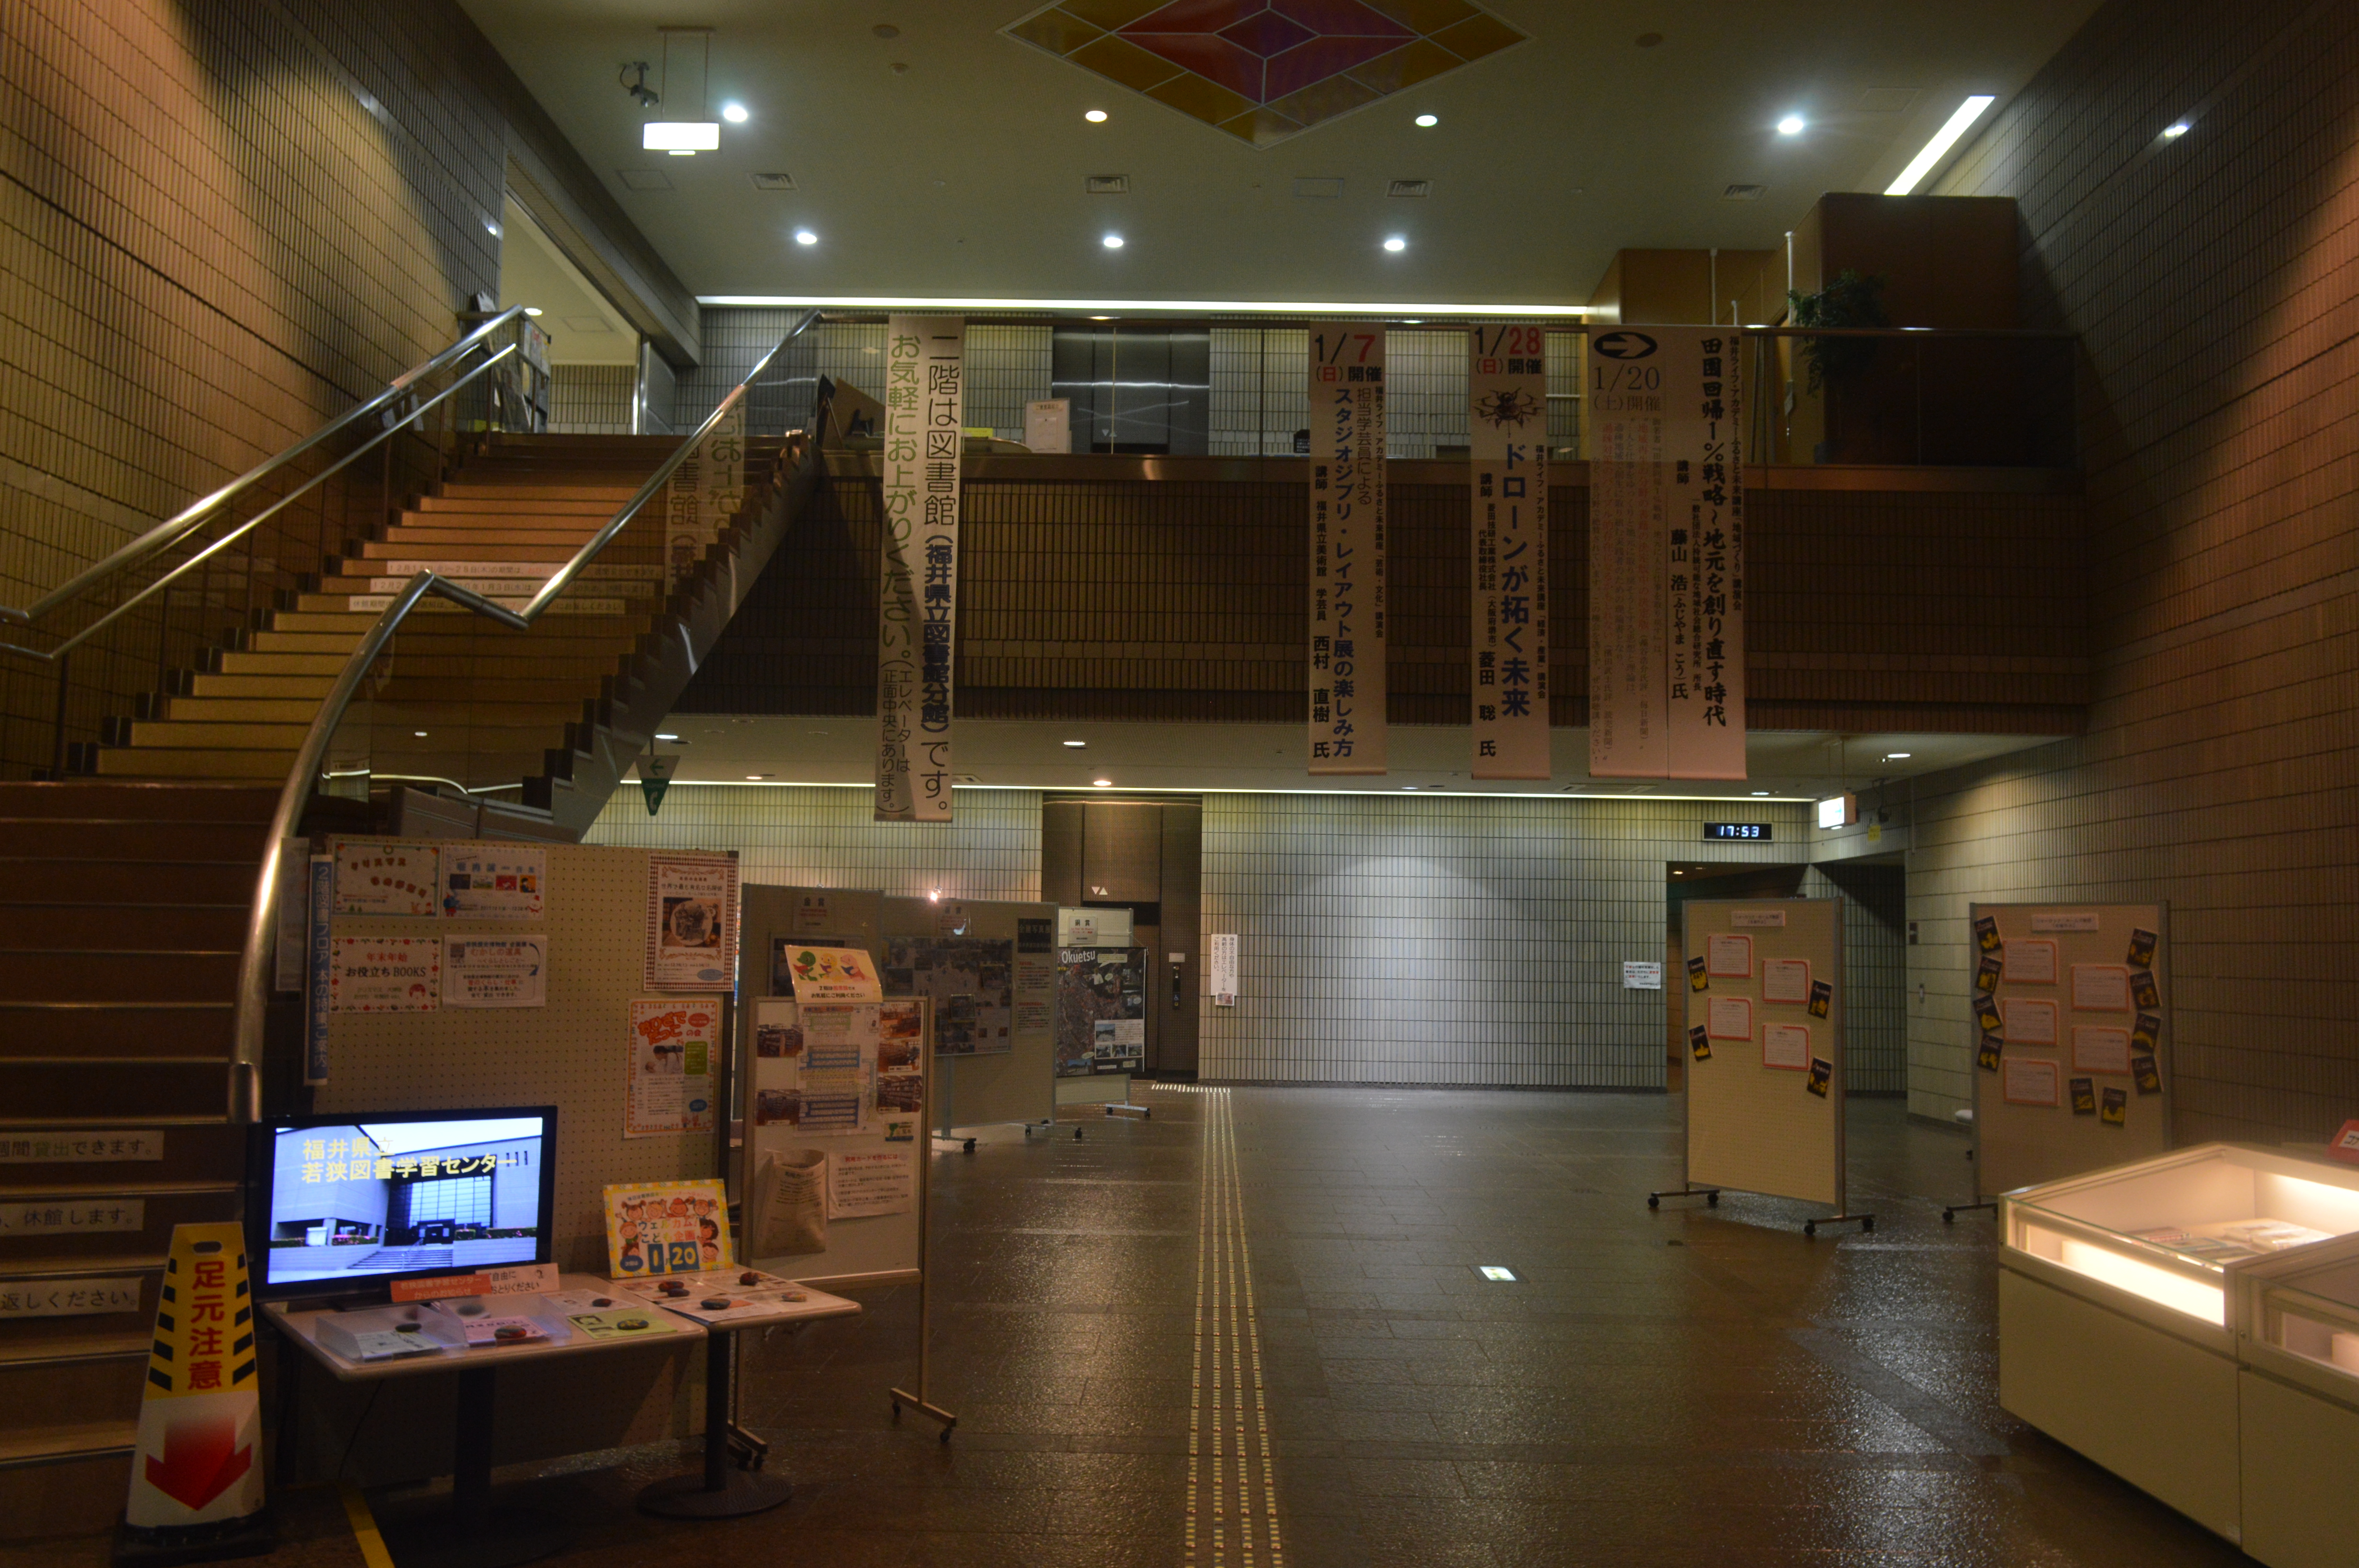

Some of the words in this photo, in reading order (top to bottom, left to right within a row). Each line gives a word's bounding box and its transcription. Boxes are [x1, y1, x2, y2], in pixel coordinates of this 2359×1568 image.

[1315, 332, 1376, 364] 1/7
[1475, 325, 1541, 356] 1/28
[1316, 366, 1382, 382] （日）開催
[1476, 358, 1542, 374] （日）開催
[1594, 364, 1660, 392] 1/20
[1357, 388, 1372, 505] 担当学芸員による
[1315, 465, 1328, 490] 講師
[1480, 473, 1492, 498] 講師
[1676, 460, 1689, 484] 講師
[882, 334, 921, 659] お気軽にお上がりください。
[1316, 501, 1327, 577] 福井県立美術館
[1670, 529, 1688, 562] 藤山
[1333, 388, 1354, 757] スタジオジブリ・レイアウト展の楽しみ方
[1501, 444, 1530, 717] ドローンが拓く未来
[1316, 588, 1327, 621] 学芸員
[1313, 635, 1330, 669] 西村
[1478, 651, 1496, 686] 菱田
[1313, 688, 1330, 722] 直樹
[1313, 742, 1330, 758] 氏
[1479, 740, 1496, 757] 氏
[1718, 826, 1759, 837] 17:53
[346, 966, 390, 977] お役立ち
[393, 967, 426, 977] BOOKS
[367, 952, 407, 962] 年末年始
[1061, 950, 1095, 964] Okuetsu
[303, 1136, 395, 1161] 福井県立
[301, 1153, 518, 1183] 若狭図書学習センター
[672, 1247, 697, 1265] 20
[188, 1260, 225, 1391] 足元注意
